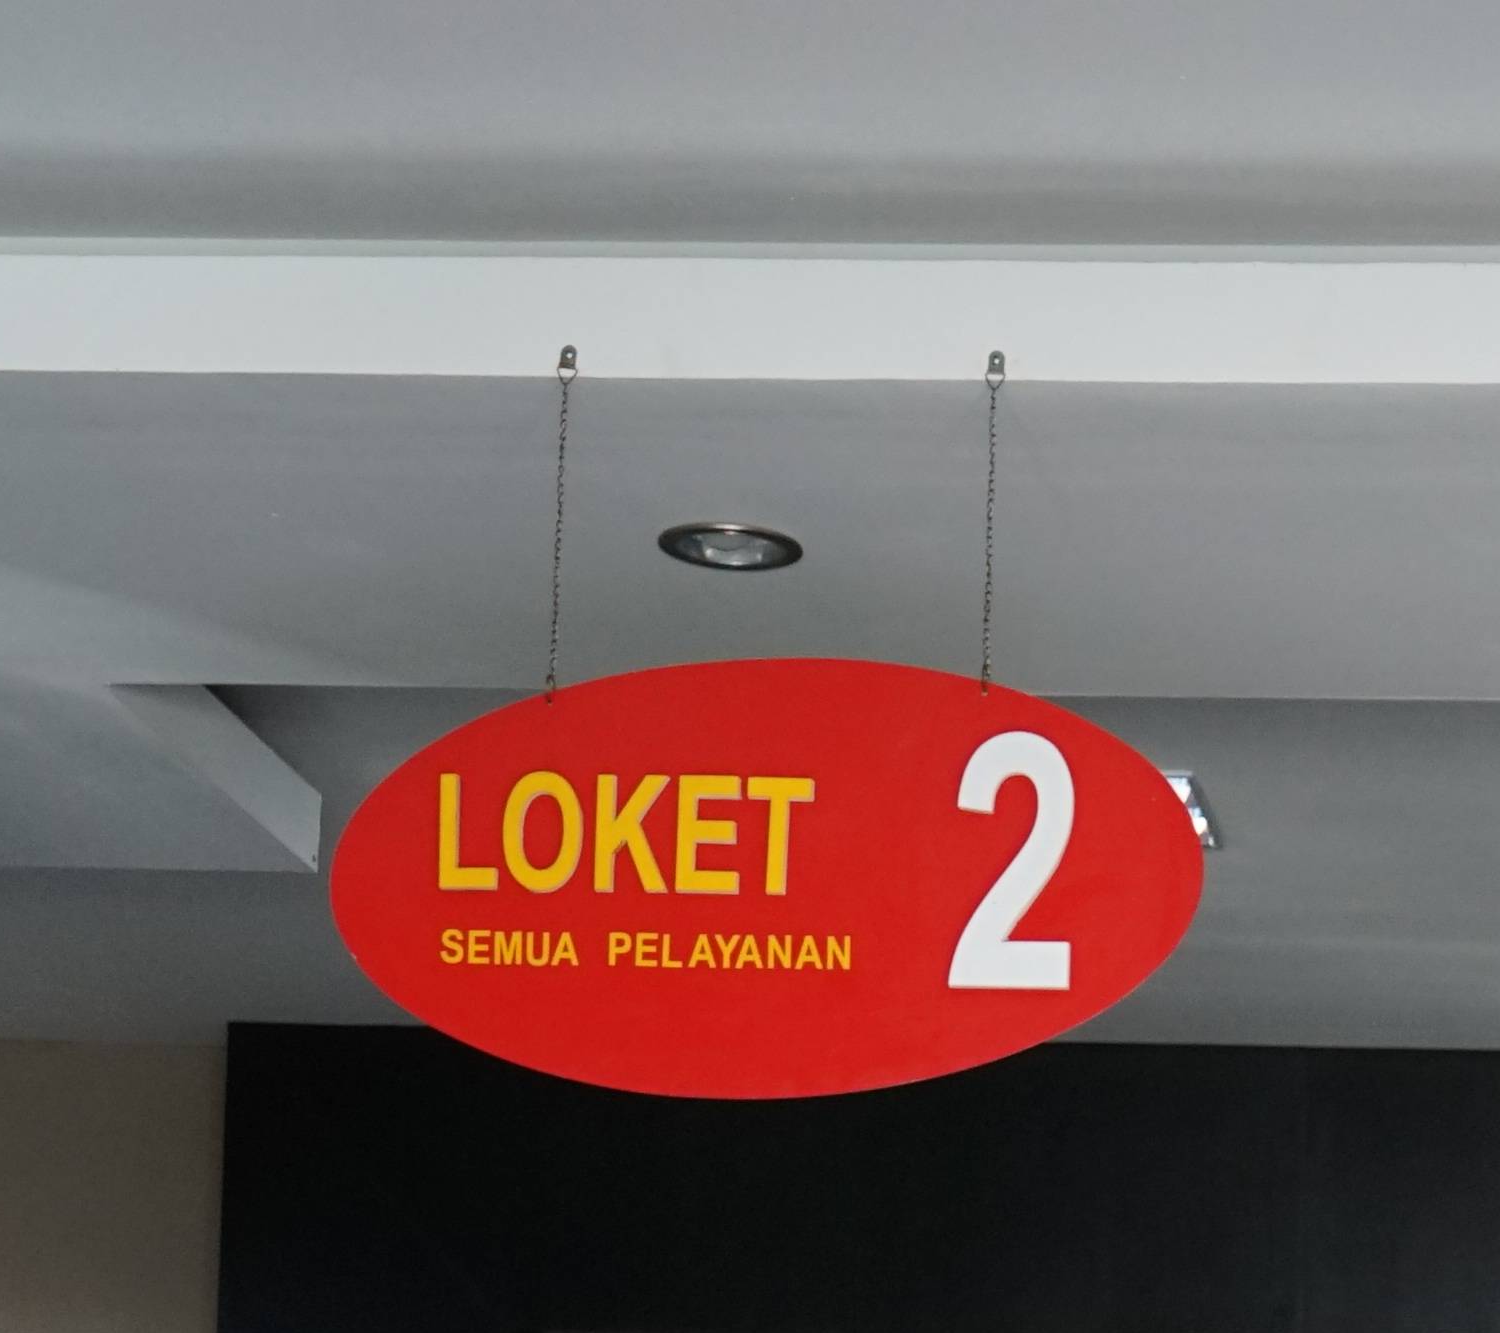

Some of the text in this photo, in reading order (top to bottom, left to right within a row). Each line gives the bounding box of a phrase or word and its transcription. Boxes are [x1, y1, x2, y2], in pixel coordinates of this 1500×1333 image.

[438, 771, 815, 896] LOKET
[948, 730, 1076, 991] 2
[440, 929, 853, 972] SEMUA PELAYANAN
